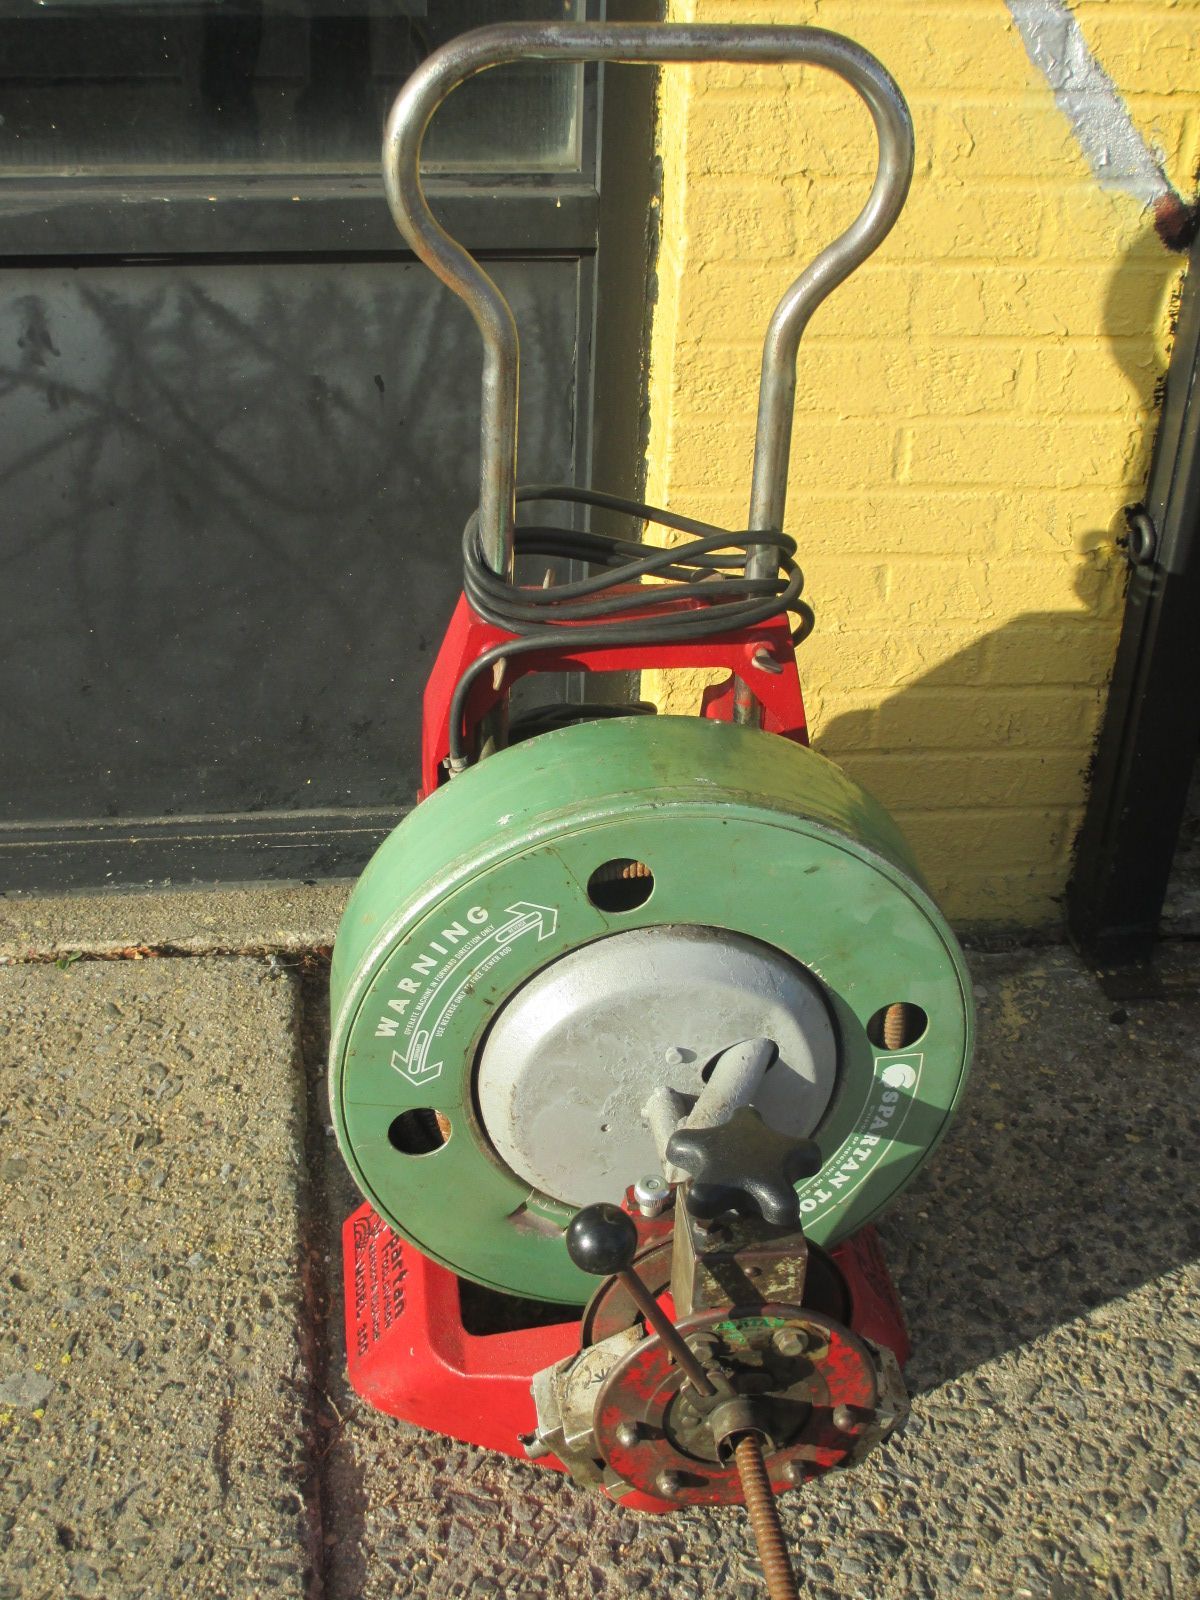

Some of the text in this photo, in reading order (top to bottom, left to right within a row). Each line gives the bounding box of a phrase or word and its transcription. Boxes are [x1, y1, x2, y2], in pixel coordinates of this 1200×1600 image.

[480, 924, 495, 937] ONLY
[455, 935, 482, 959] DIRECTION
[375, 906, 489, 1037] WARNING
[434, 958, 457, 981] FORWARD
[430, 980, 439, 988] IN
[435, 1026, 446, 1037] USE
[441, 1004, 458, 1026] REVERSE
[454, 990, 466, 1004] ONLY
[470, 971, 484, 983] FREE
[482, 955, 502, 972] SEWER
[499, 946, 512, 957] ROD
[415, 988, 433, 1011] MACHINE
[404, 1011, 420, 1035] OPERATE
[799, 1091, 900, 1218] SPARTAN TO
